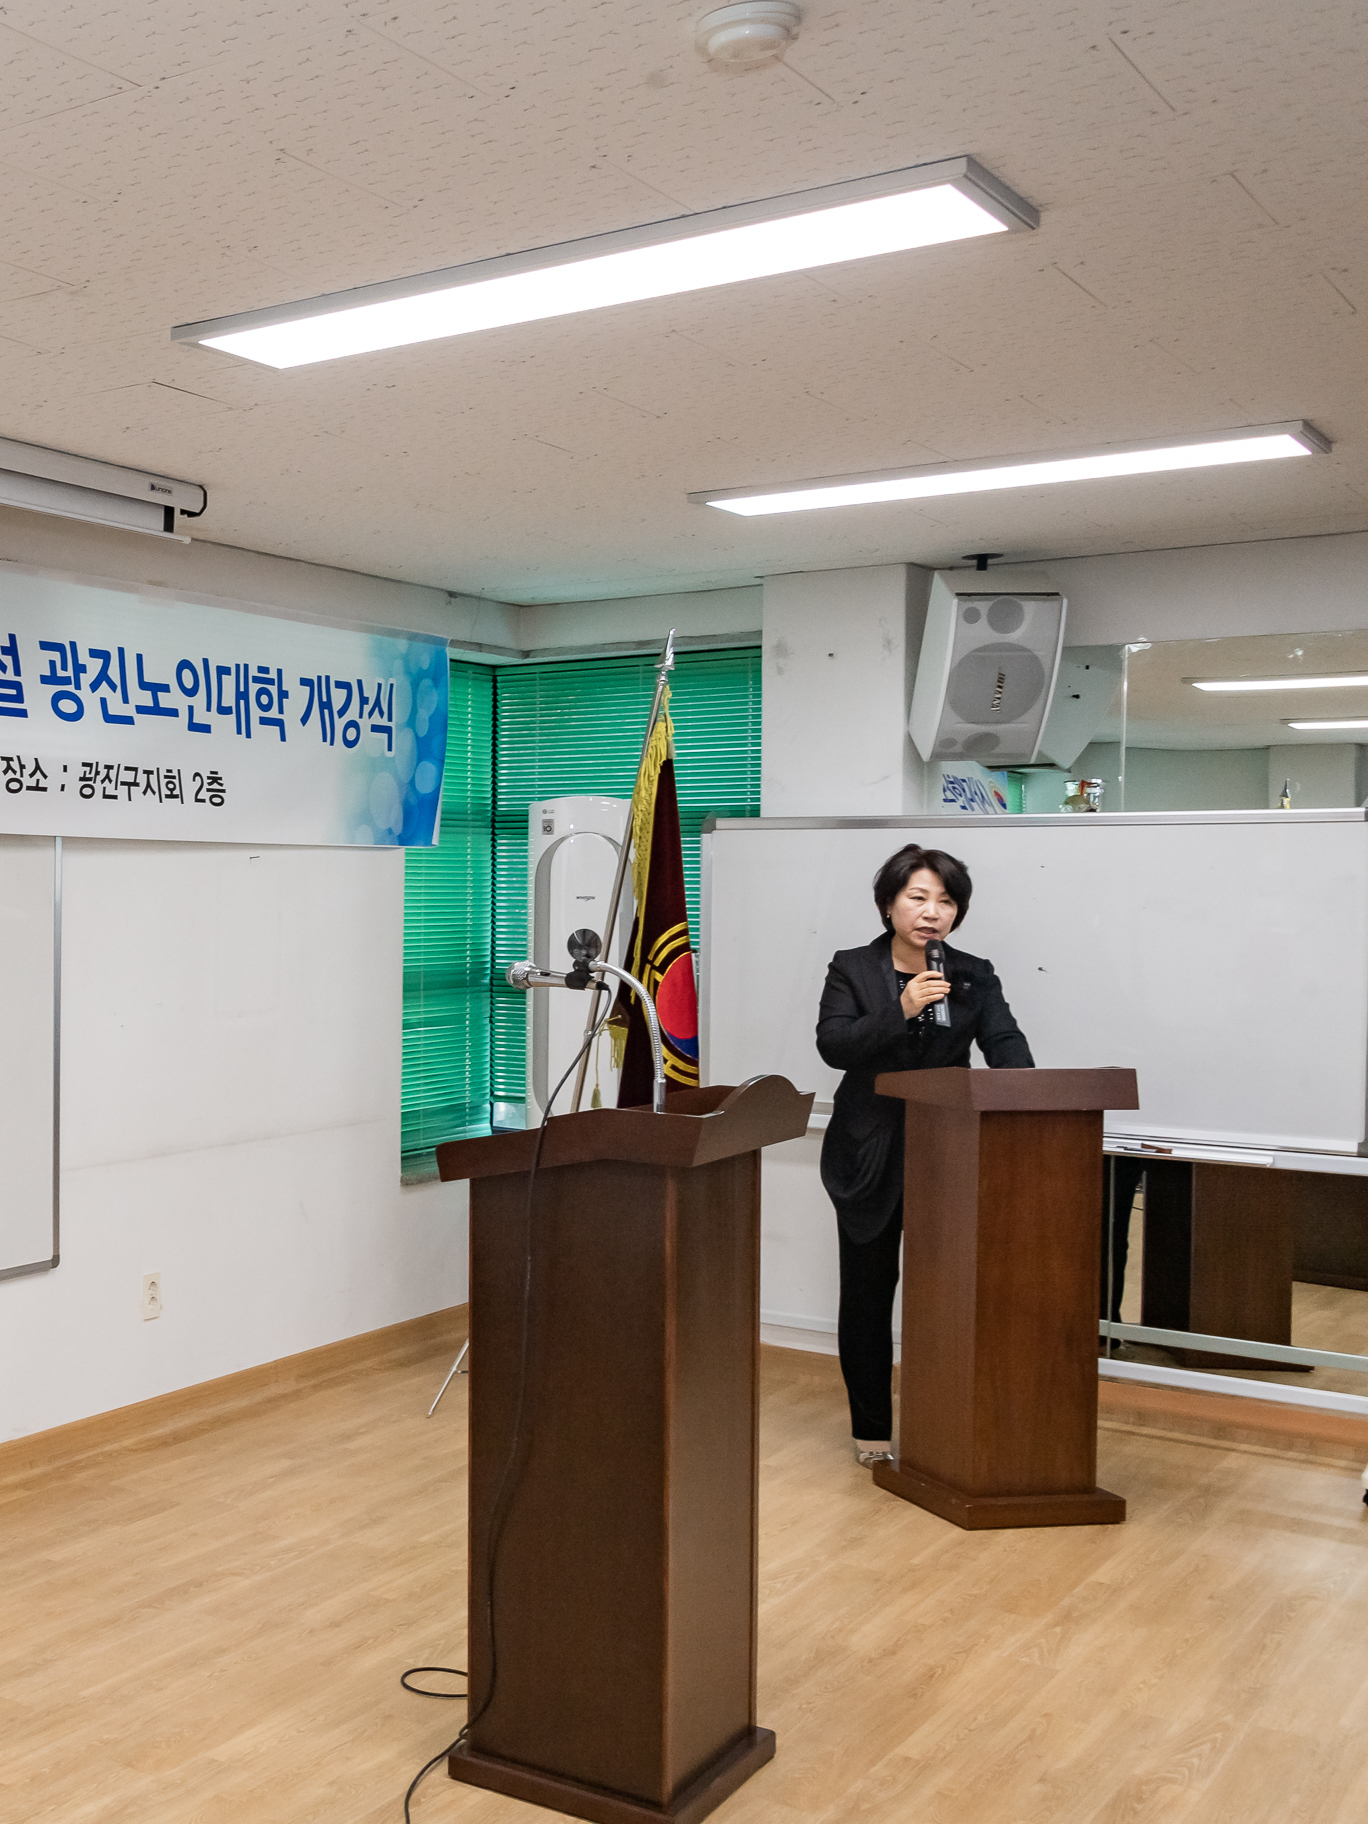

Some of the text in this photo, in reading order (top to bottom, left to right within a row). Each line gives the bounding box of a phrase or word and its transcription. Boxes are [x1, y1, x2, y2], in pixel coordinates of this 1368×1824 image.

[38, 640, 289, 742] 광진노인대학
[300, 675, 395, 752] 개강식
[0, 755, 49, 794] 장소
[79, 761, 185, 805] 광진구지회
[193, 770, 227, 807] 2층
